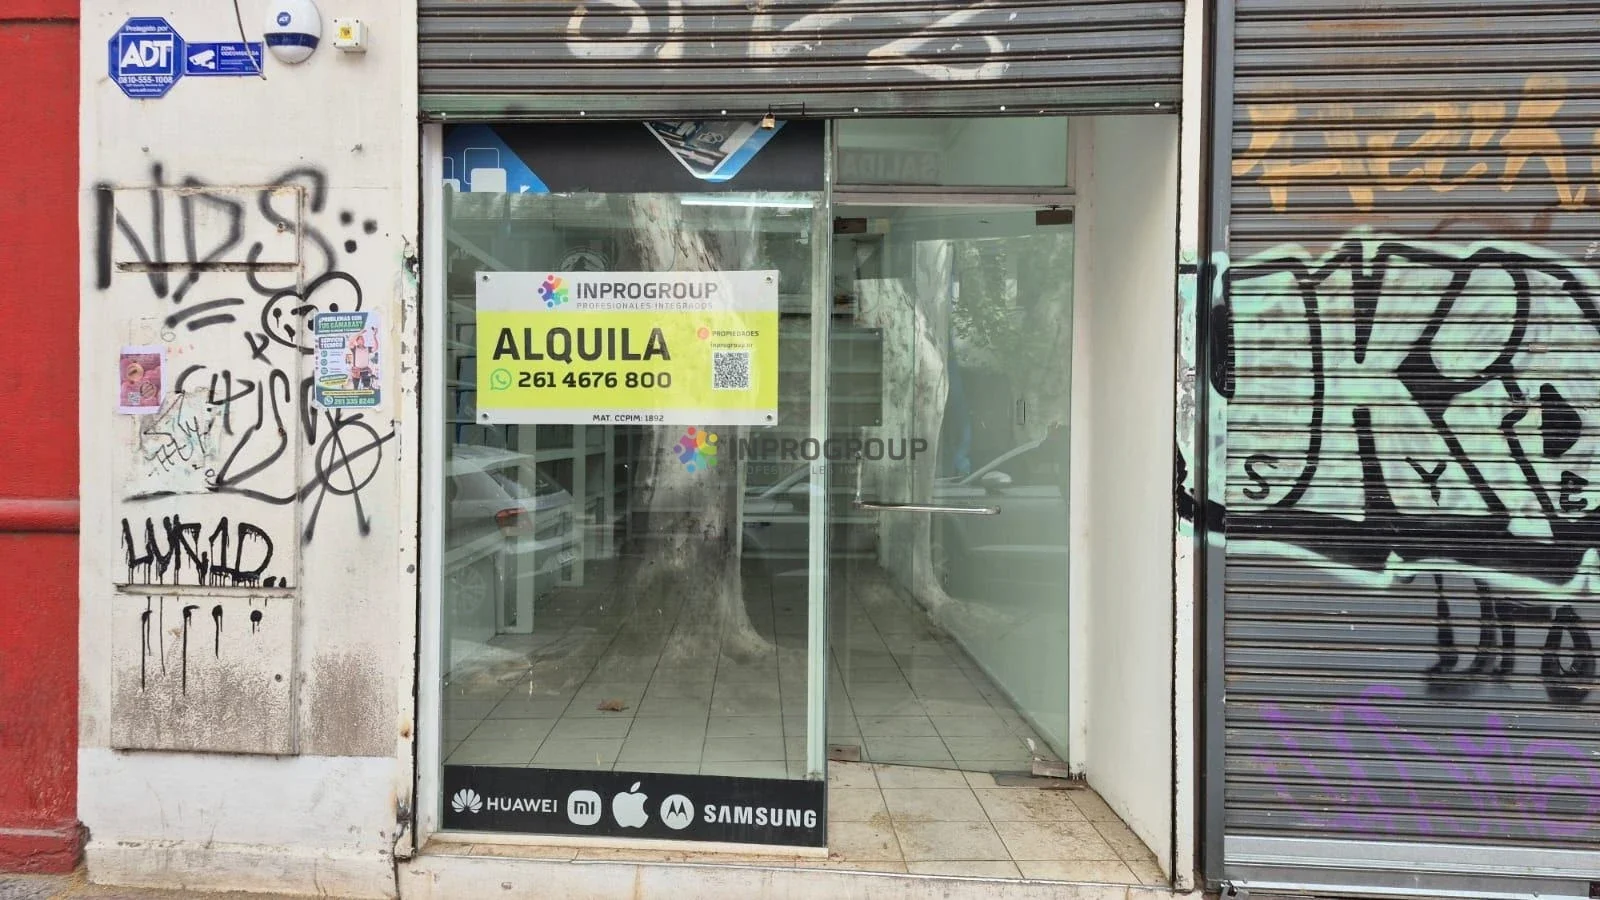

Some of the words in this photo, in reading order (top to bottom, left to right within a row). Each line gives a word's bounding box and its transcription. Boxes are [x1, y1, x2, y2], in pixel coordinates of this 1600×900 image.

[120, 39, 173, 68] ADT
[118, 76, 174, 84] 0810-555-1008
[576, 282, 719, 300] INPROGROUP
[576, 302, 651, 310] PROFESIONALES
[655, 302, 714, 310] INTEGRADOS
[492, 327, 671, 365] ALQUILA
[518, 371, 557, 388] 261
[562, 371, 618, 388] 4676
[625, 371, 672, 388] 800
[614, 414, 643, 422] CCPIM:
[645, 414, 664, 422] 1892
[487, 797, 558, 813] HUAWEI
[703, 803, 817, 829] SAMSUNG
